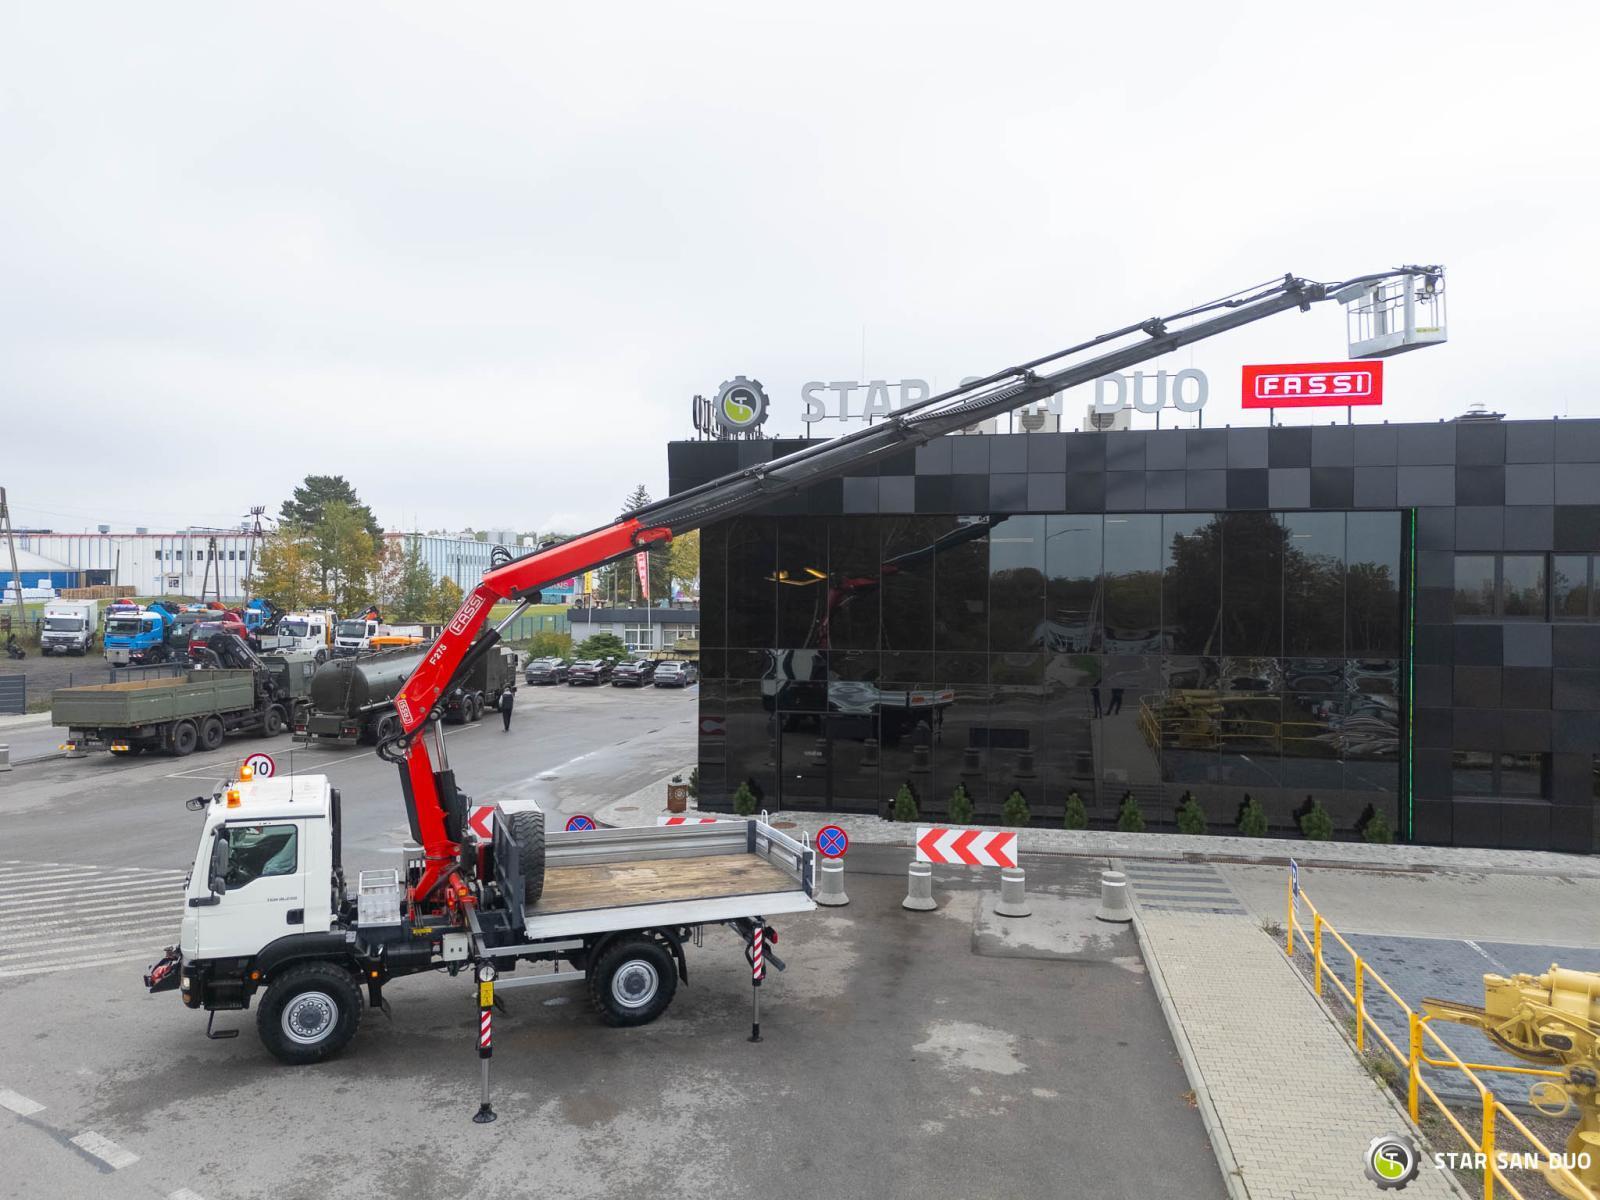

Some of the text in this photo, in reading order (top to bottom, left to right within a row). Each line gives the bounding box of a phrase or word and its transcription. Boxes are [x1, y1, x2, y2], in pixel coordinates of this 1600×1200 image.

[1096, 369, 1209, 413] DUO
[1264, 375, 1363, 395] FASSI
[451, 594, 484, 633] FASSI
[429, 644, 447, 665] F275
[252, 761, 269, 776] 10
